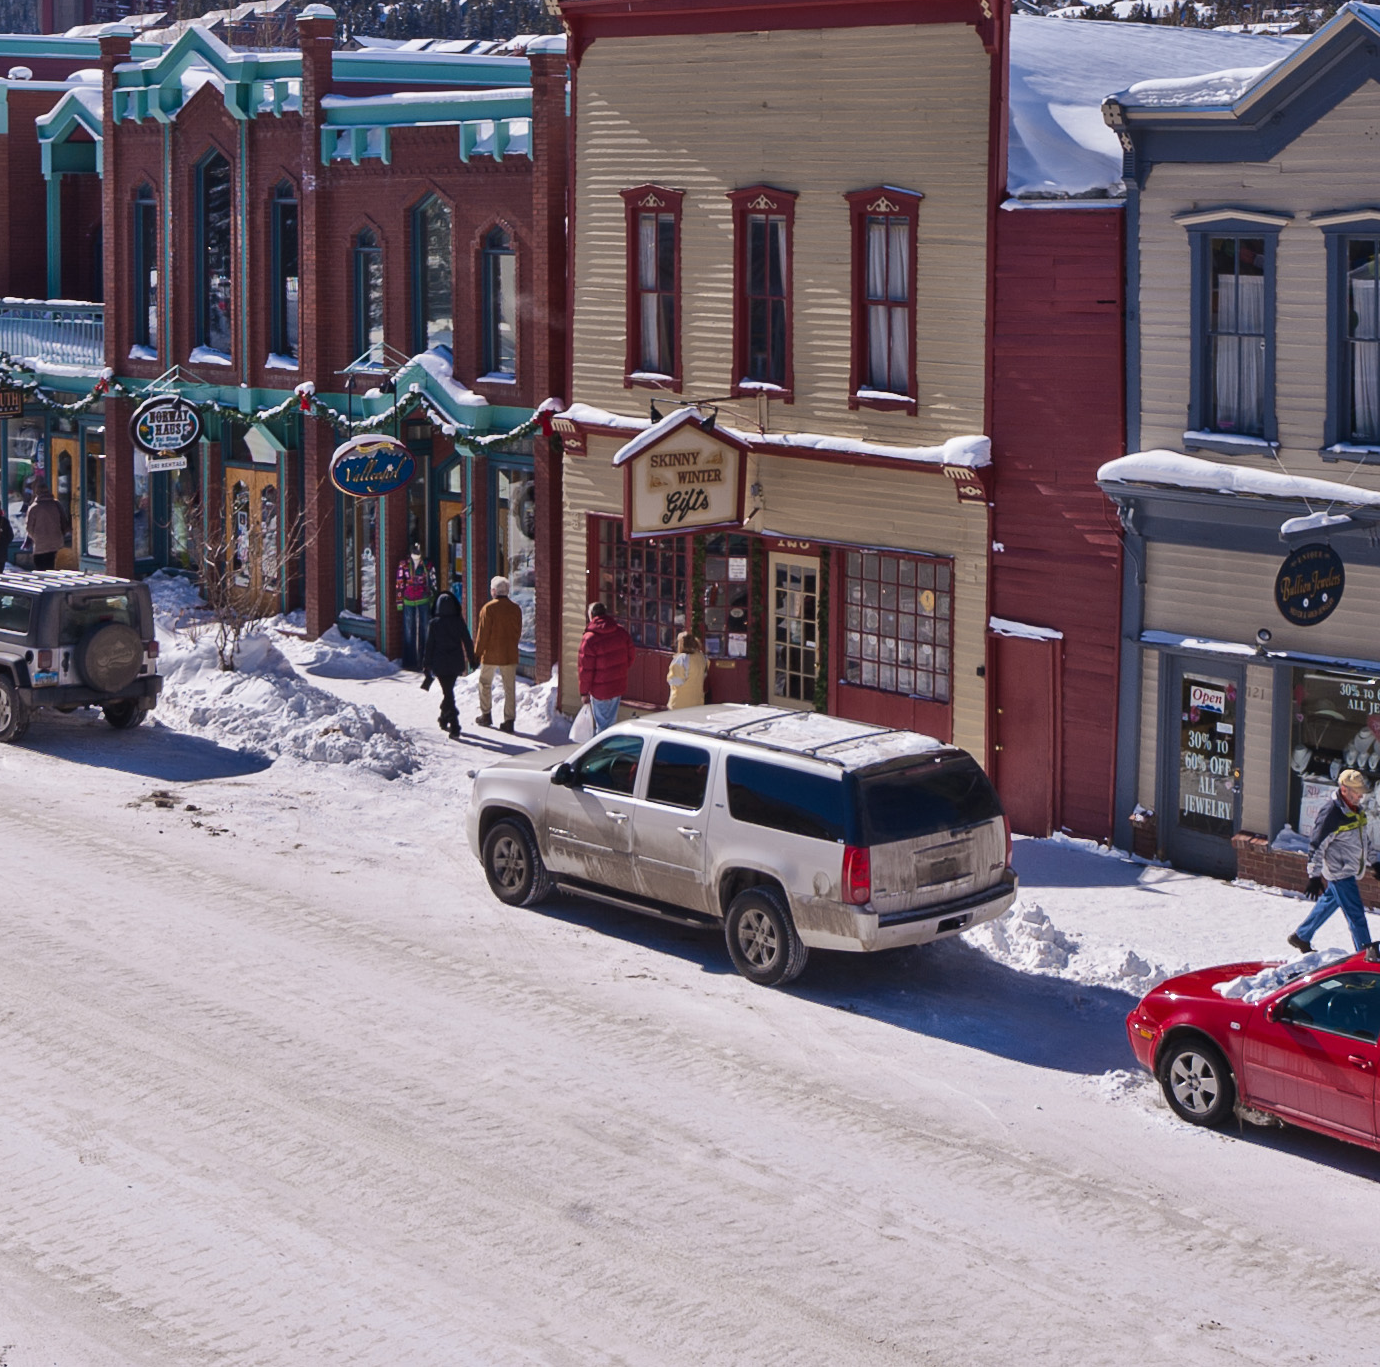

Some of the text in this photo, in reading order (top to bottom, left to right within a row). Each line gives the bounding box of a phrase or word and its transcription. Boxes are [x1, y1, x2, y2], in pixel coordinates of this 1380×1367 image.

[148, 410, 190, 423] NORWAY
[155, 423, 182, 435] HAUS
[650, 452, 701, 468] SKINNY
[677, 469, 722, 485] WINTER
[662, 488, 709, 524] Gifts
[1281, 566, 1341, 602] Bullion Jewelers
[1192, 688, 1222, 705] Open
[1340, 682, 1360, 697] 30%
[1363, 688, 1374, 700] TO
[1347, 699, 1366, 711] ALL
[1188, 730, 1229, 754] 30% TO
[1185, 752, 1232, 776] 60% OFF
[1198, 775, 1217, 796] ALL
[1183, 794, 1232, 821] JEWELRY
